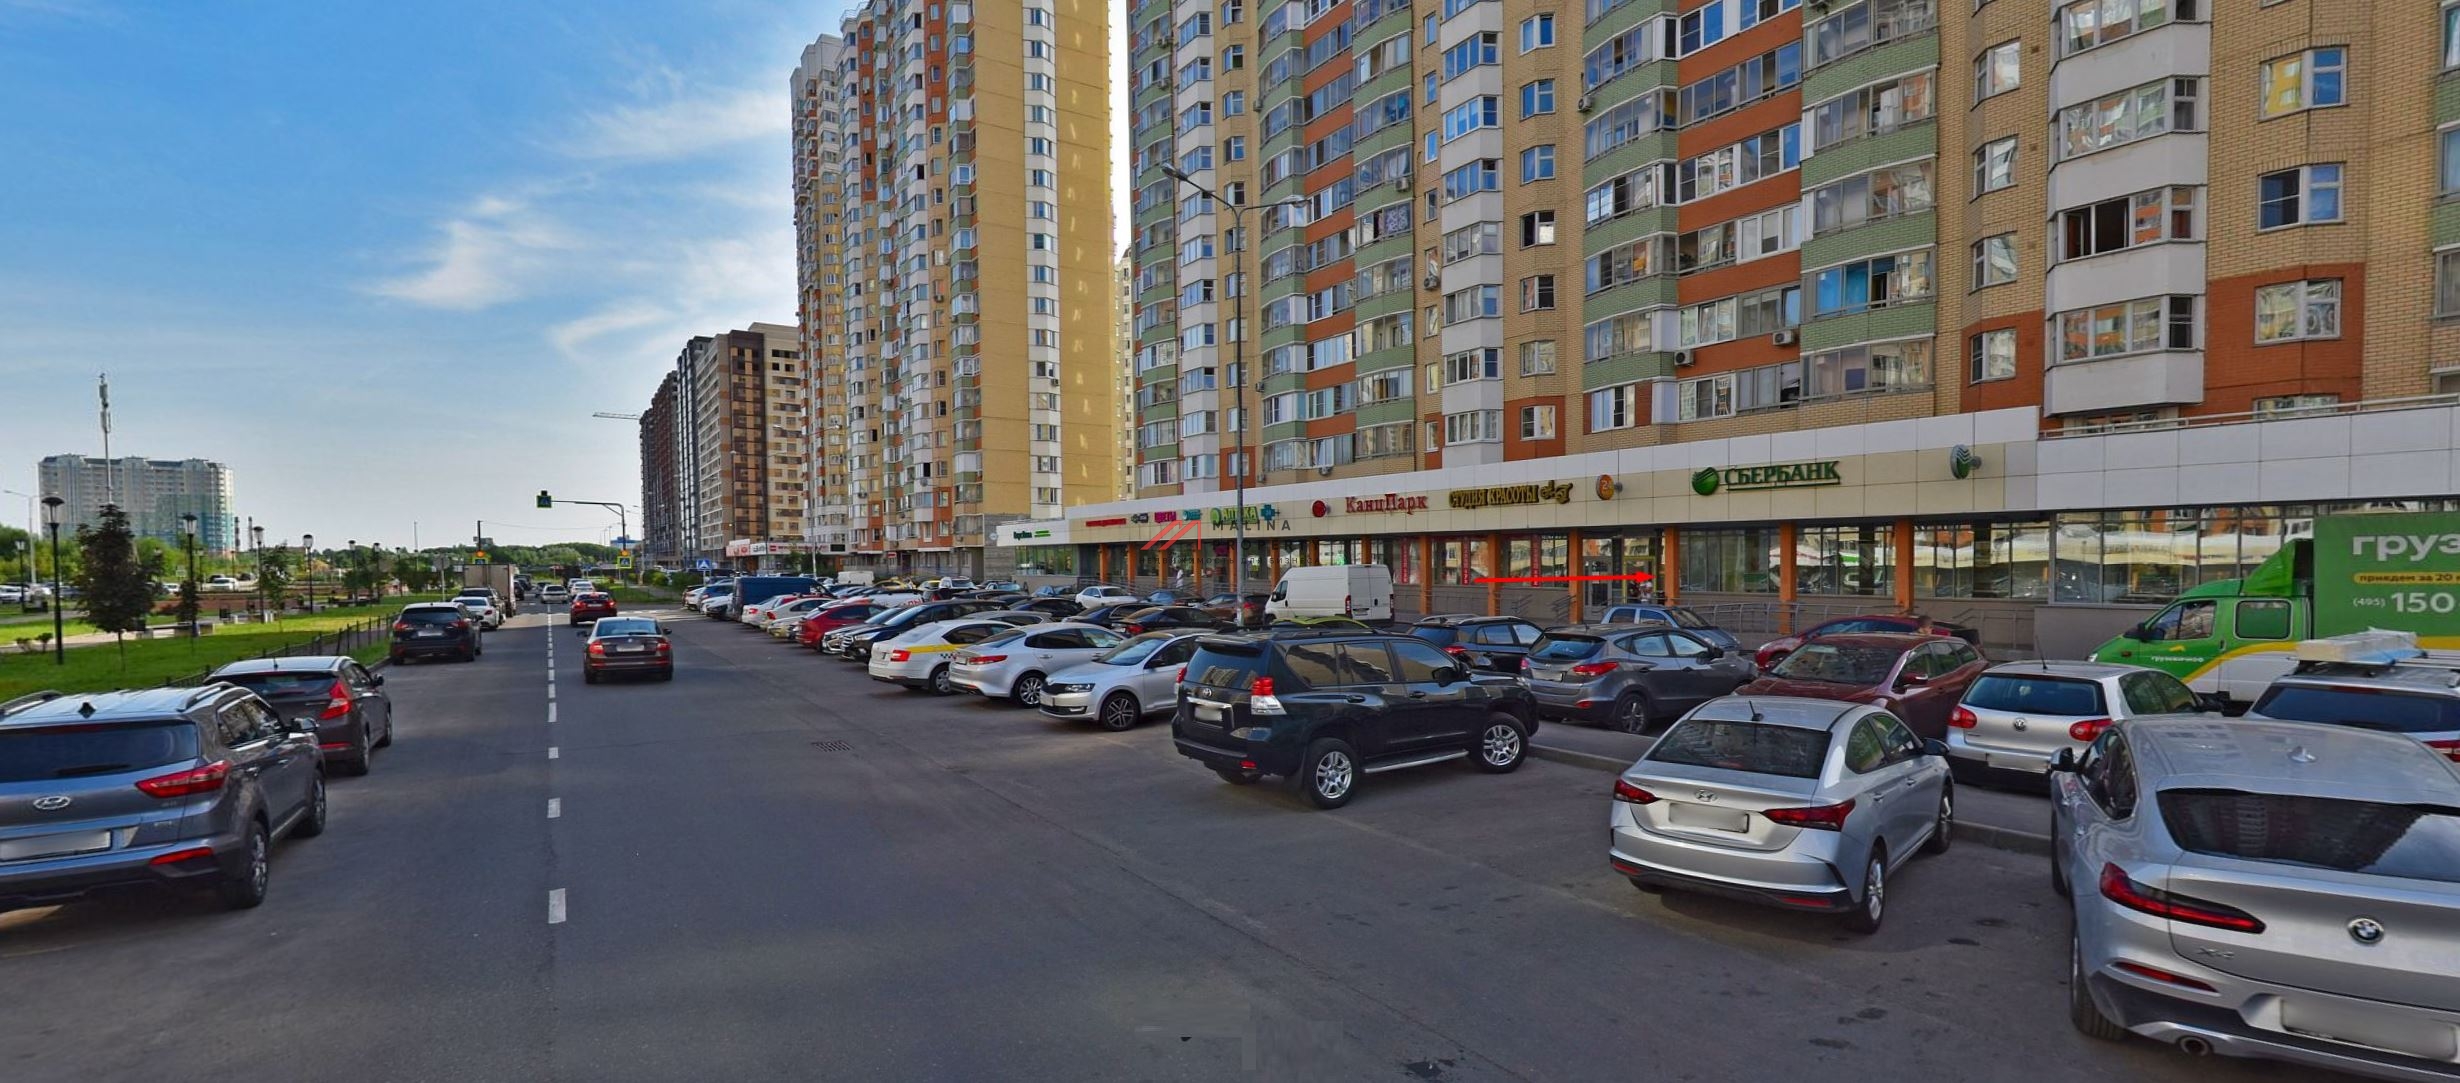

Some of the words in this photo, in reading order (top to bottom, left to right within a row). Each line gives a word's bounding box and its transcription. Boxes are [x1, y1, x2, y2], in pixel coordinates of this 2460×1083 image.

[1724, 461, 1840, 484] СБЕРБАНК
[1345, 493, 1428, 514] КанцПарк
[1449, 489, 1487, 509] СТУДИЯ
[1488, 485, 1540, 505] КРАСОТЫ
[2353, 597, 2386, 608] (495)
